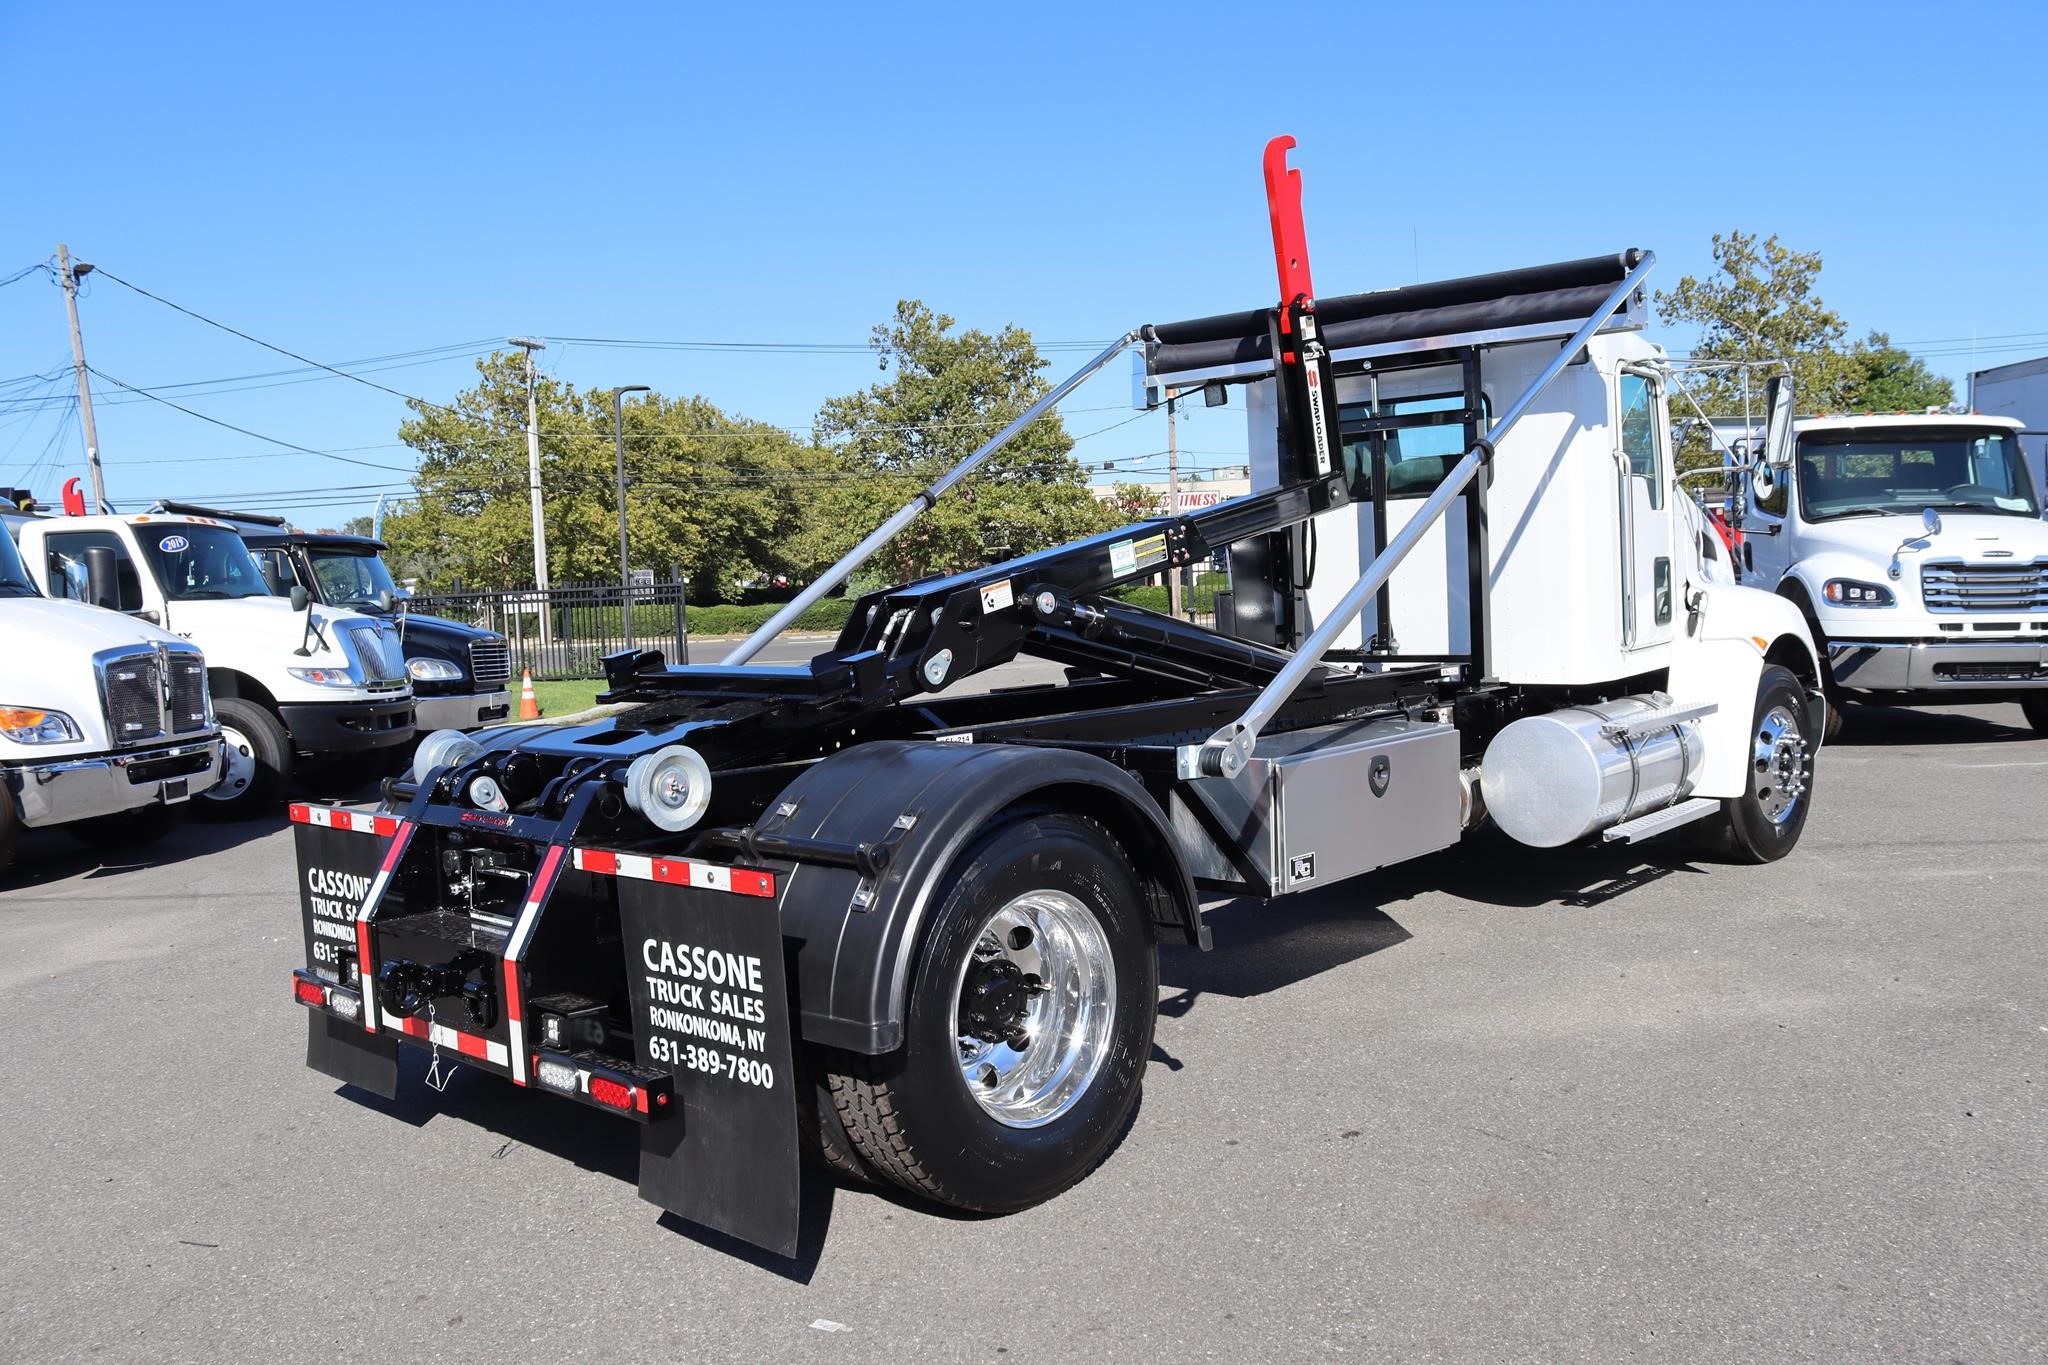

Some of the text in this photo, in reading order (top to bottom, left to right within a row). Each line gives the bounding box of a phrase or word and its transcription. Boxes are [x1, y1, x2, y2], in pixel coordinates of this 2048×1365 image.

[1311, 390, 1325, 464] SWAPLOADER
[166, 537, 184, 550] 2019
[311, 896, 343, 919] TRUCK
[643, 939, 763, 992] CASSONE
[646, 976, 766, 1024] TRUCK SALES
[649, 1005, 766, 1053] RONKONKOMA, NY
[649, 1035, 774, 1089] 631-389-7800
